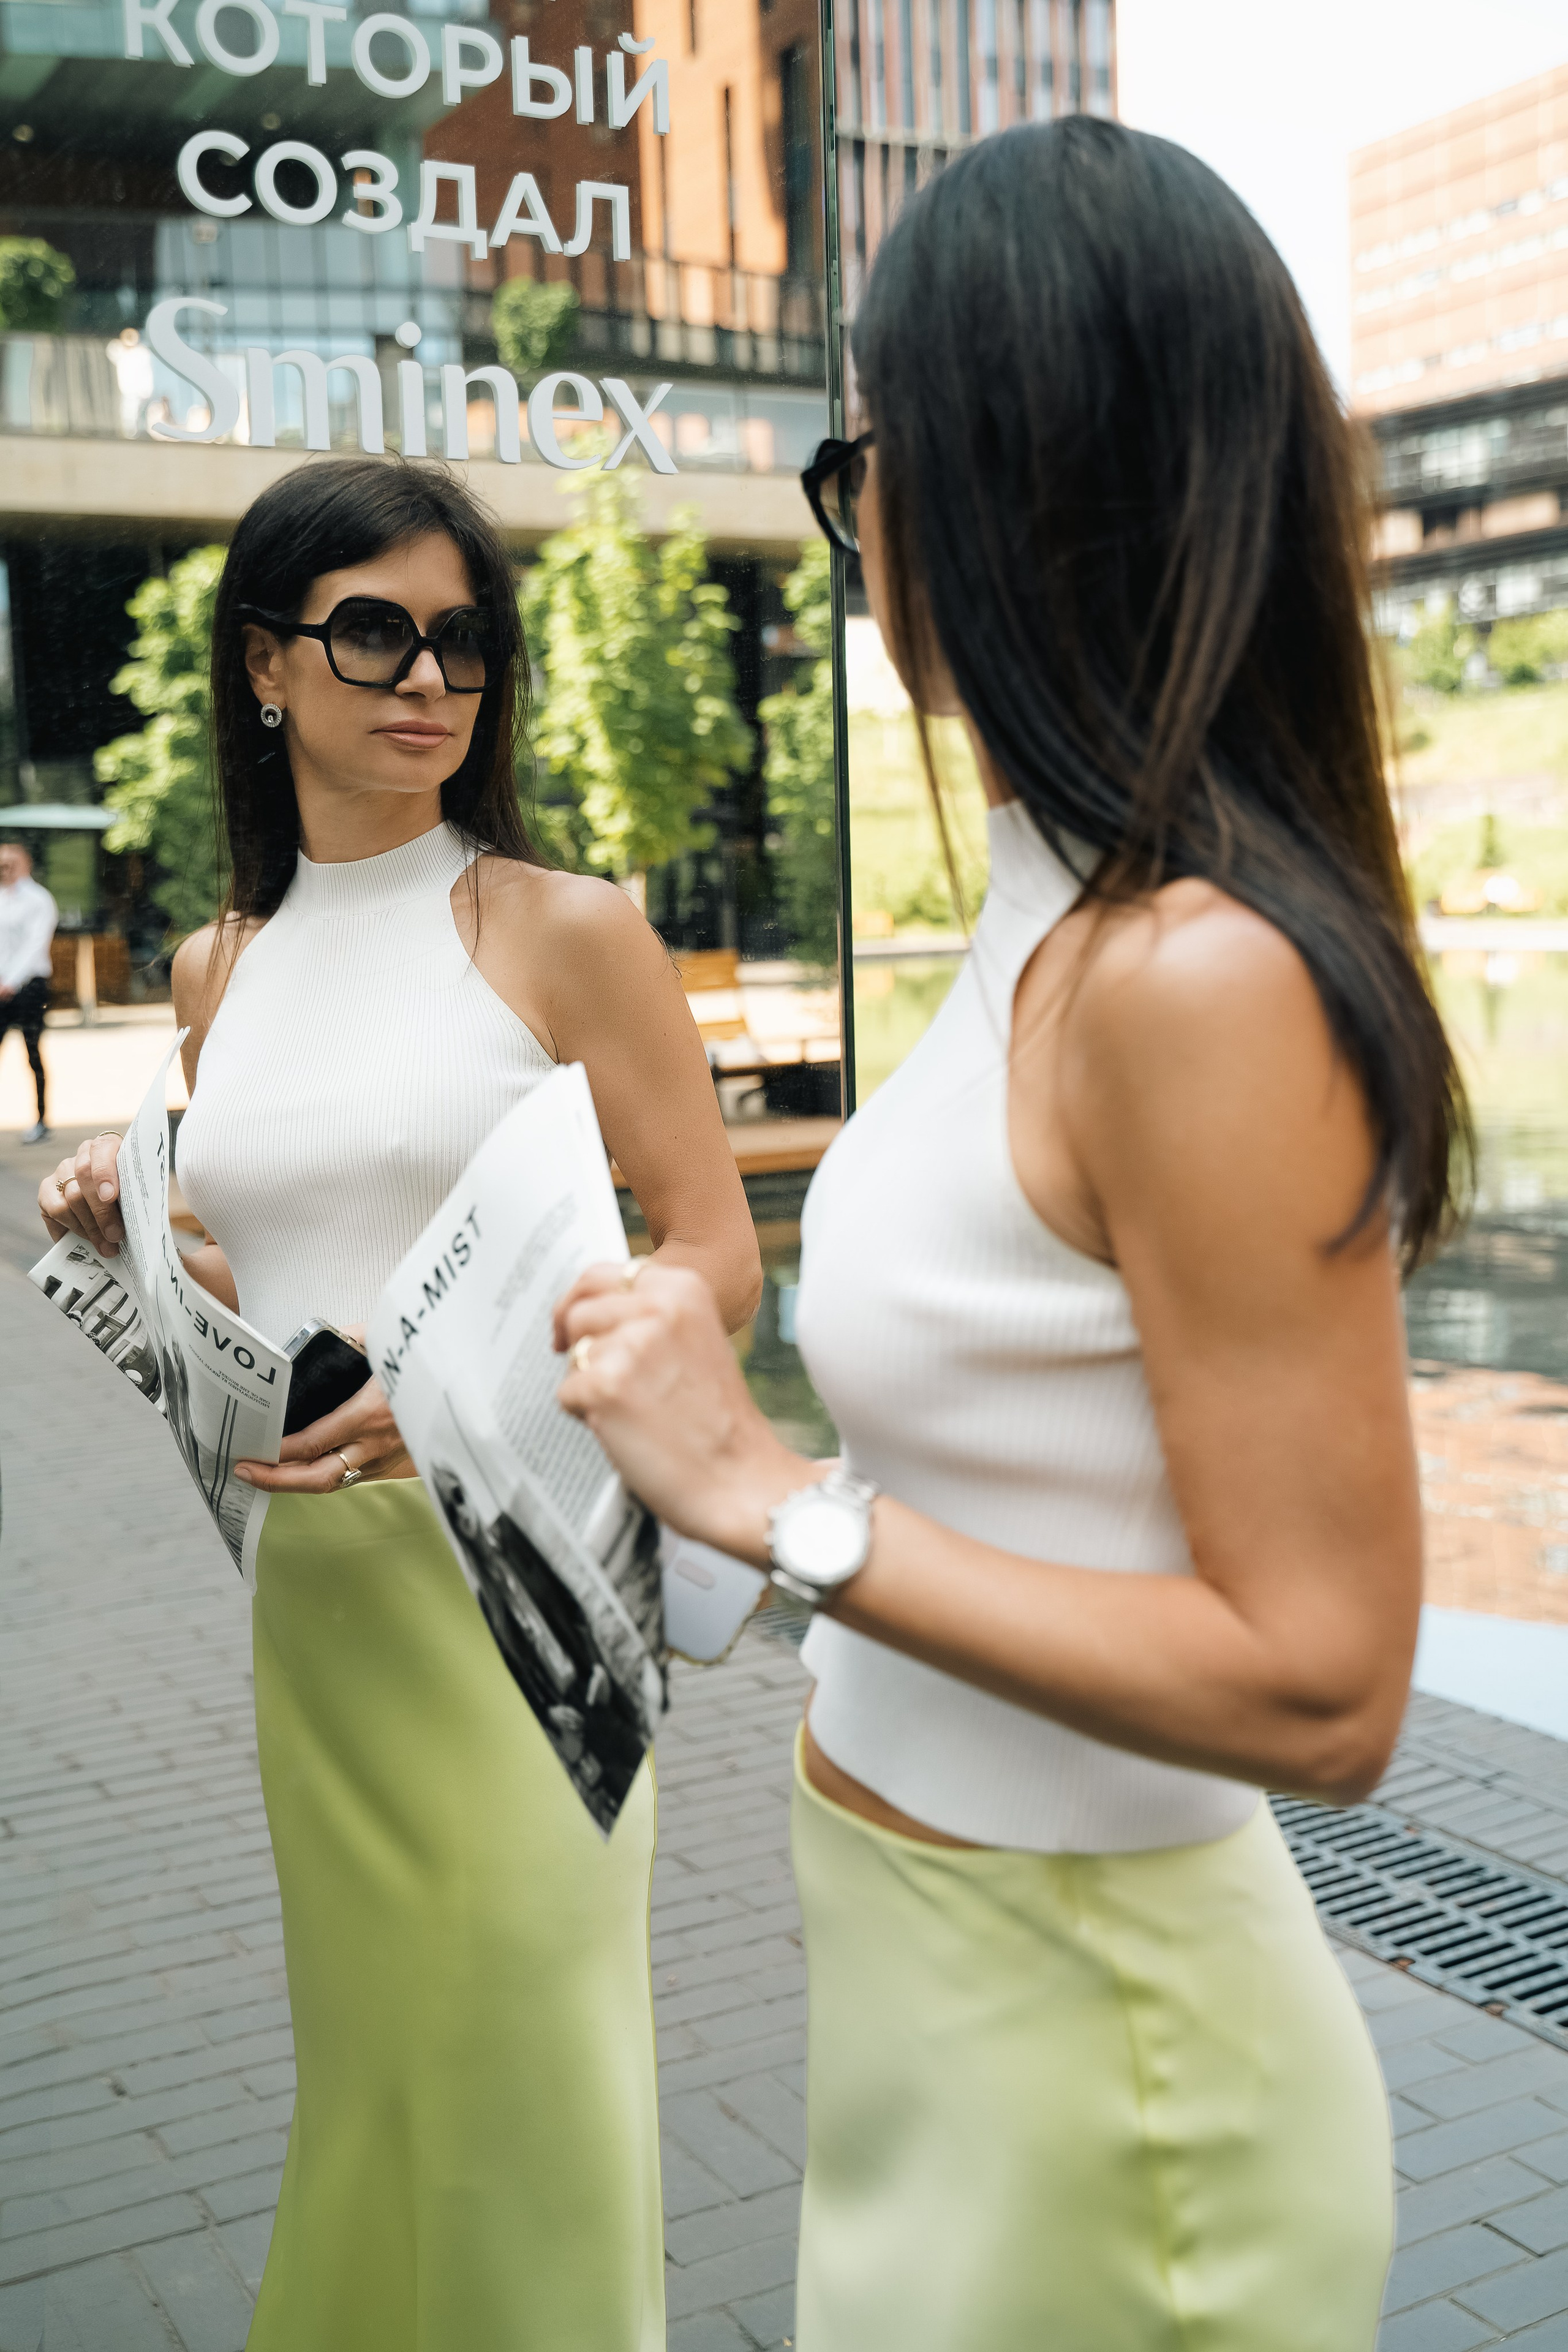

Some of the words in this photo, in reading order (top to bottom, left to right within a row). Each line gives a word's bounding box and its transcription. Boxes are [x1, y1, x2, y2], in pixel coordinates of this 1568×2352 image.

[124, 0, 669, 135] КОТОРЫЙ
[178, 130, 631, 262] СОЗДАЛ
[146, 297, 678, 475] Sminex
